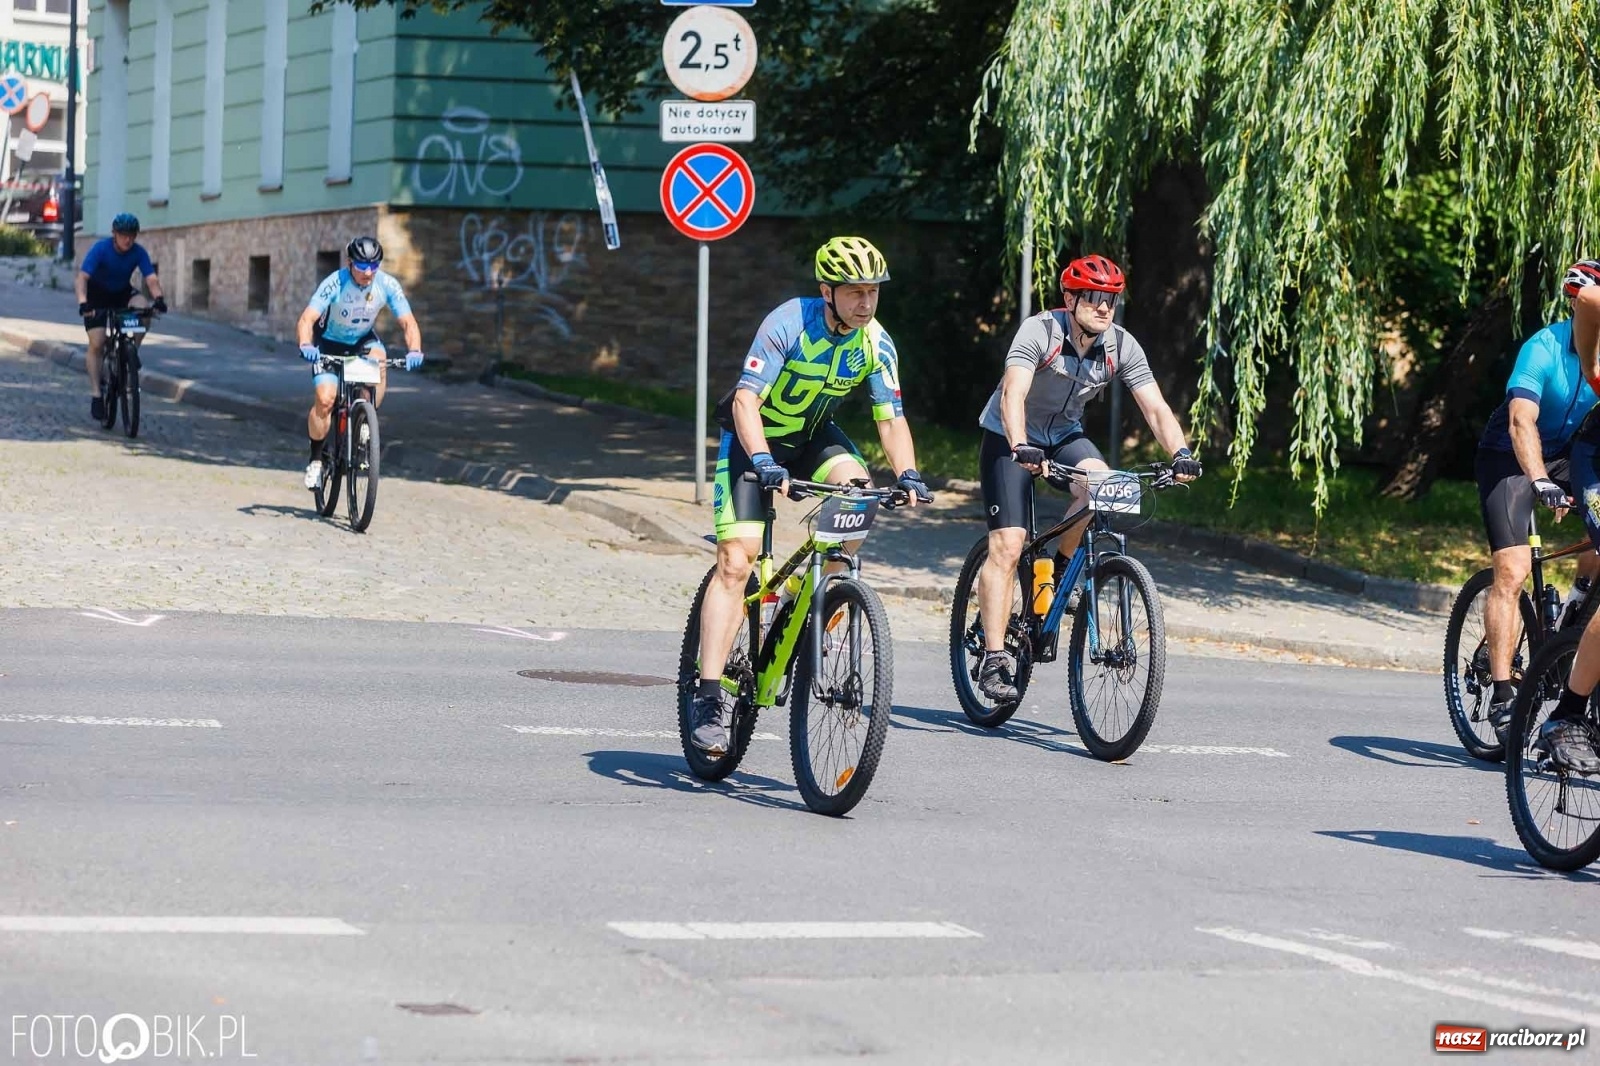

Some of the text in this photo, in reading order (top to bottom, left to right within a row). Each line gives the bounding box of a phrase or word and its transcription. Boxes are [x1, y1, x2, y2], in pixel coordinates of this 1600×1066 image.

[0, 40, 81, 96] ARNI
[668, 106, 747, 121] Nie dotyczy
[833, 513, 865, 528] 1100
